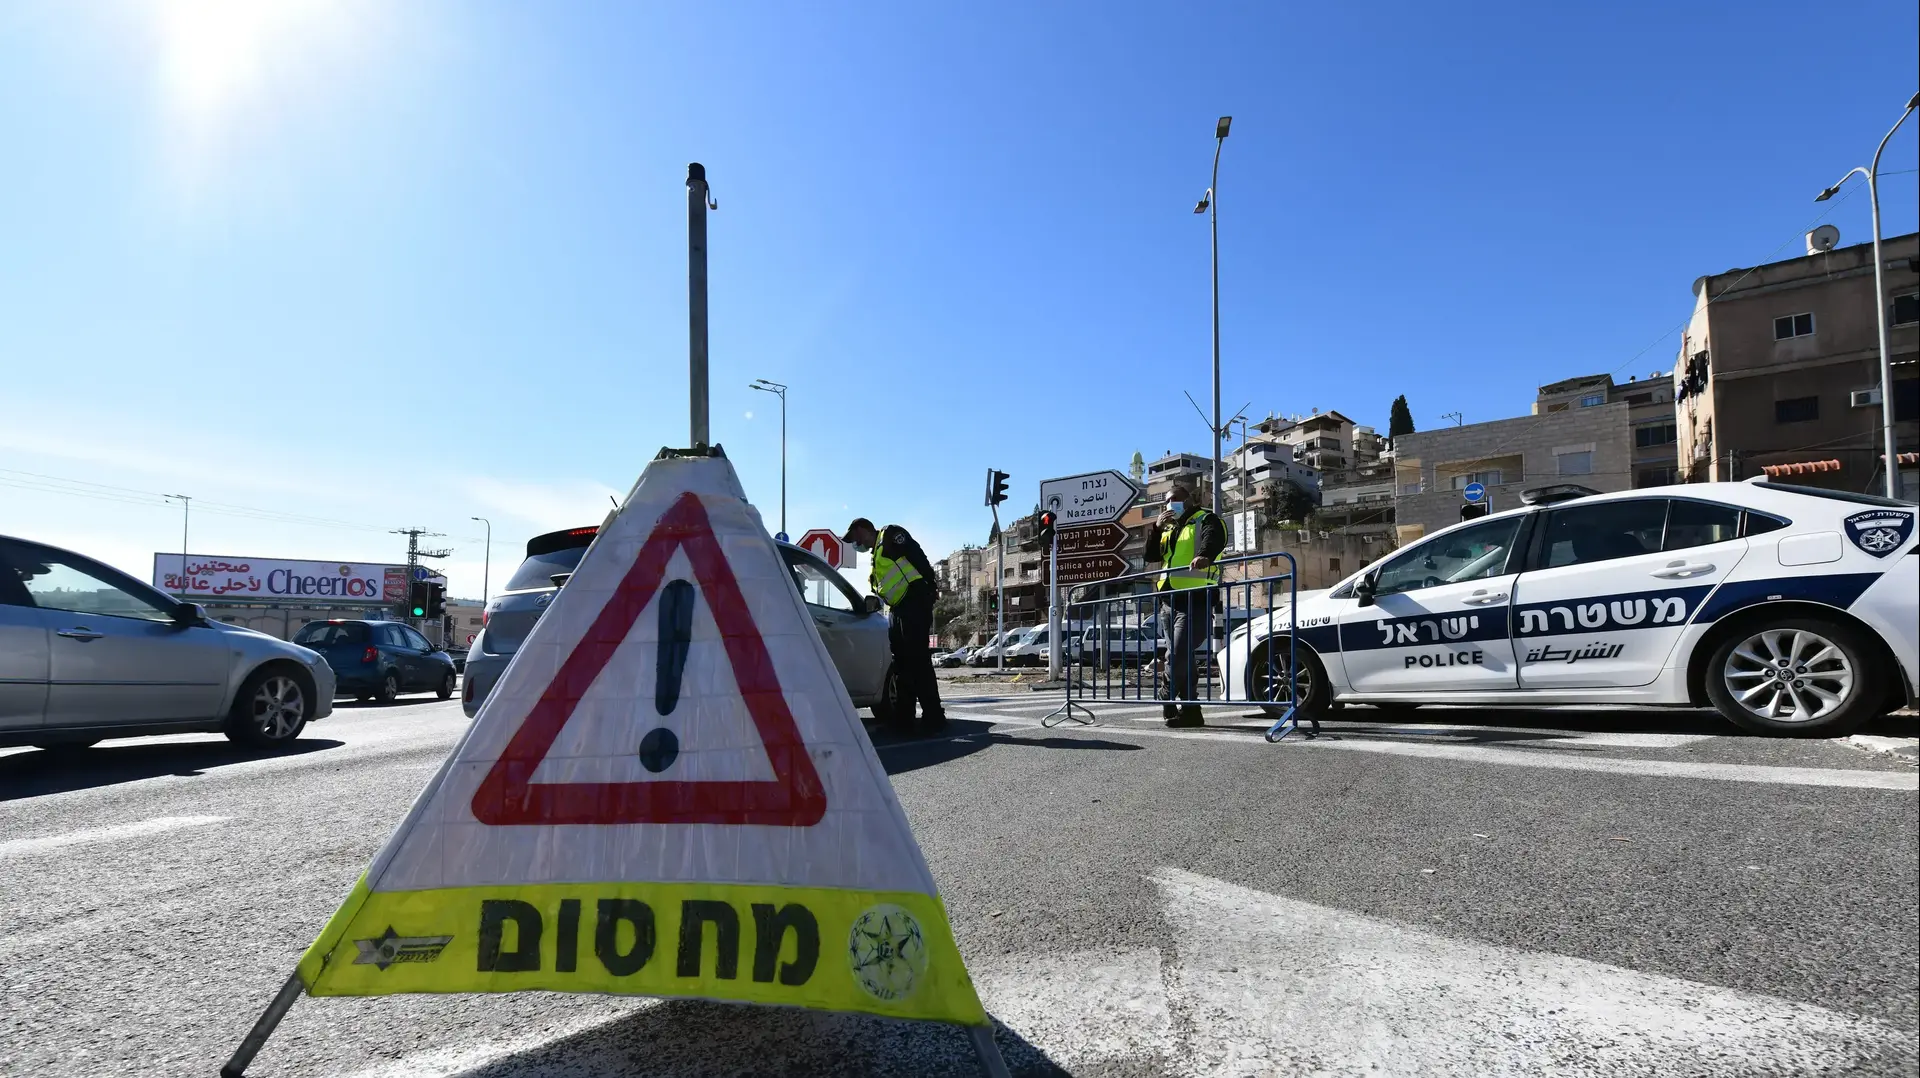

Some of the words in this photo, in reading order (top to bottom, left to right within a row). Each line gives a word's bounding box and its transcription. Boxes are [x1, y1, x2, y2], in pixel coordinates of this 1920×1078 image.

[1082, 478, 1107, 490] נצרת
[1074, 492, 1108, 506] الناصرة
[1067, 505, 1116, 518] Nazareth
[1847, 512, 1875, 523] ישראל
[1876, 511, 1910, 519] משטרת
[1056, 531, 1080, 541] הבשור
[1084, 527, 1111, 538] כנסיית
[186, 560, 250, 576] صحتين
[1086, 560, 1095, 568] of
[164, 573, 210, 590] عائلة
[267, 566, 378, 597] Cheerios
[1056, 571, 1110, 581] nnunciation
[212, 575, 261, 594] لأحلى
[1300, 616, 1331, 627] שיטור
[1520, 596, 1687, 633] משטרת
[1377, 615, 1479, 645] ישראל
[1525, 640, 1626, 664] الشرطة
[1404, 650, 1484, 669] POLICE
[477, 898, 820, 986] מחסום
